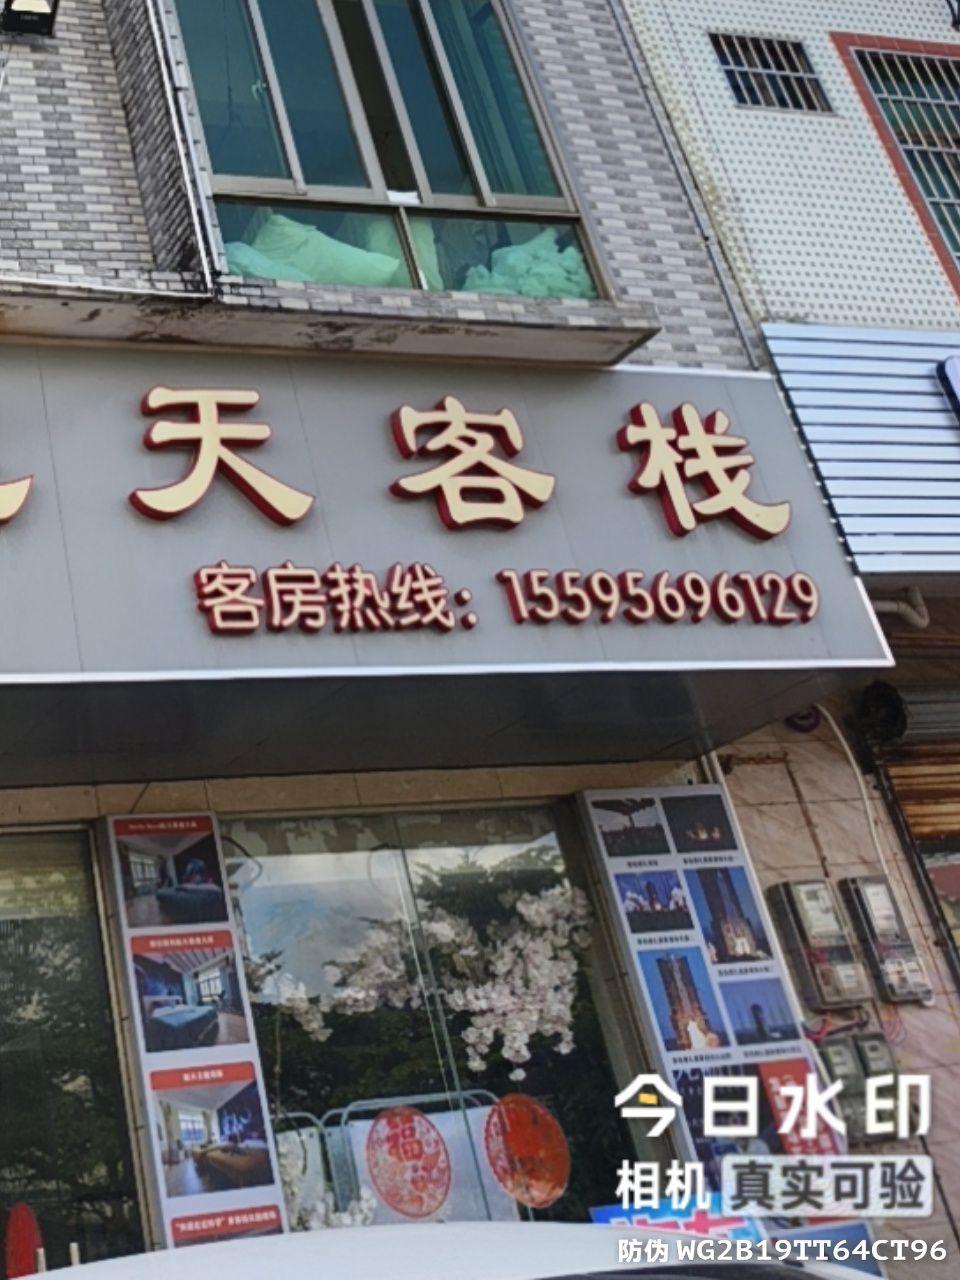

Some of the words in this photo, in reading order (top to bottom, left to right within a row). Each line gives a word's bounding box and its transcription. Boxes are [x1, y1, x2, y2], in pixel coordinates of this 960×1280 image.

[193, 560, 478, 635] 客房热线：
[495, 568, 821, 625] 15595696129
